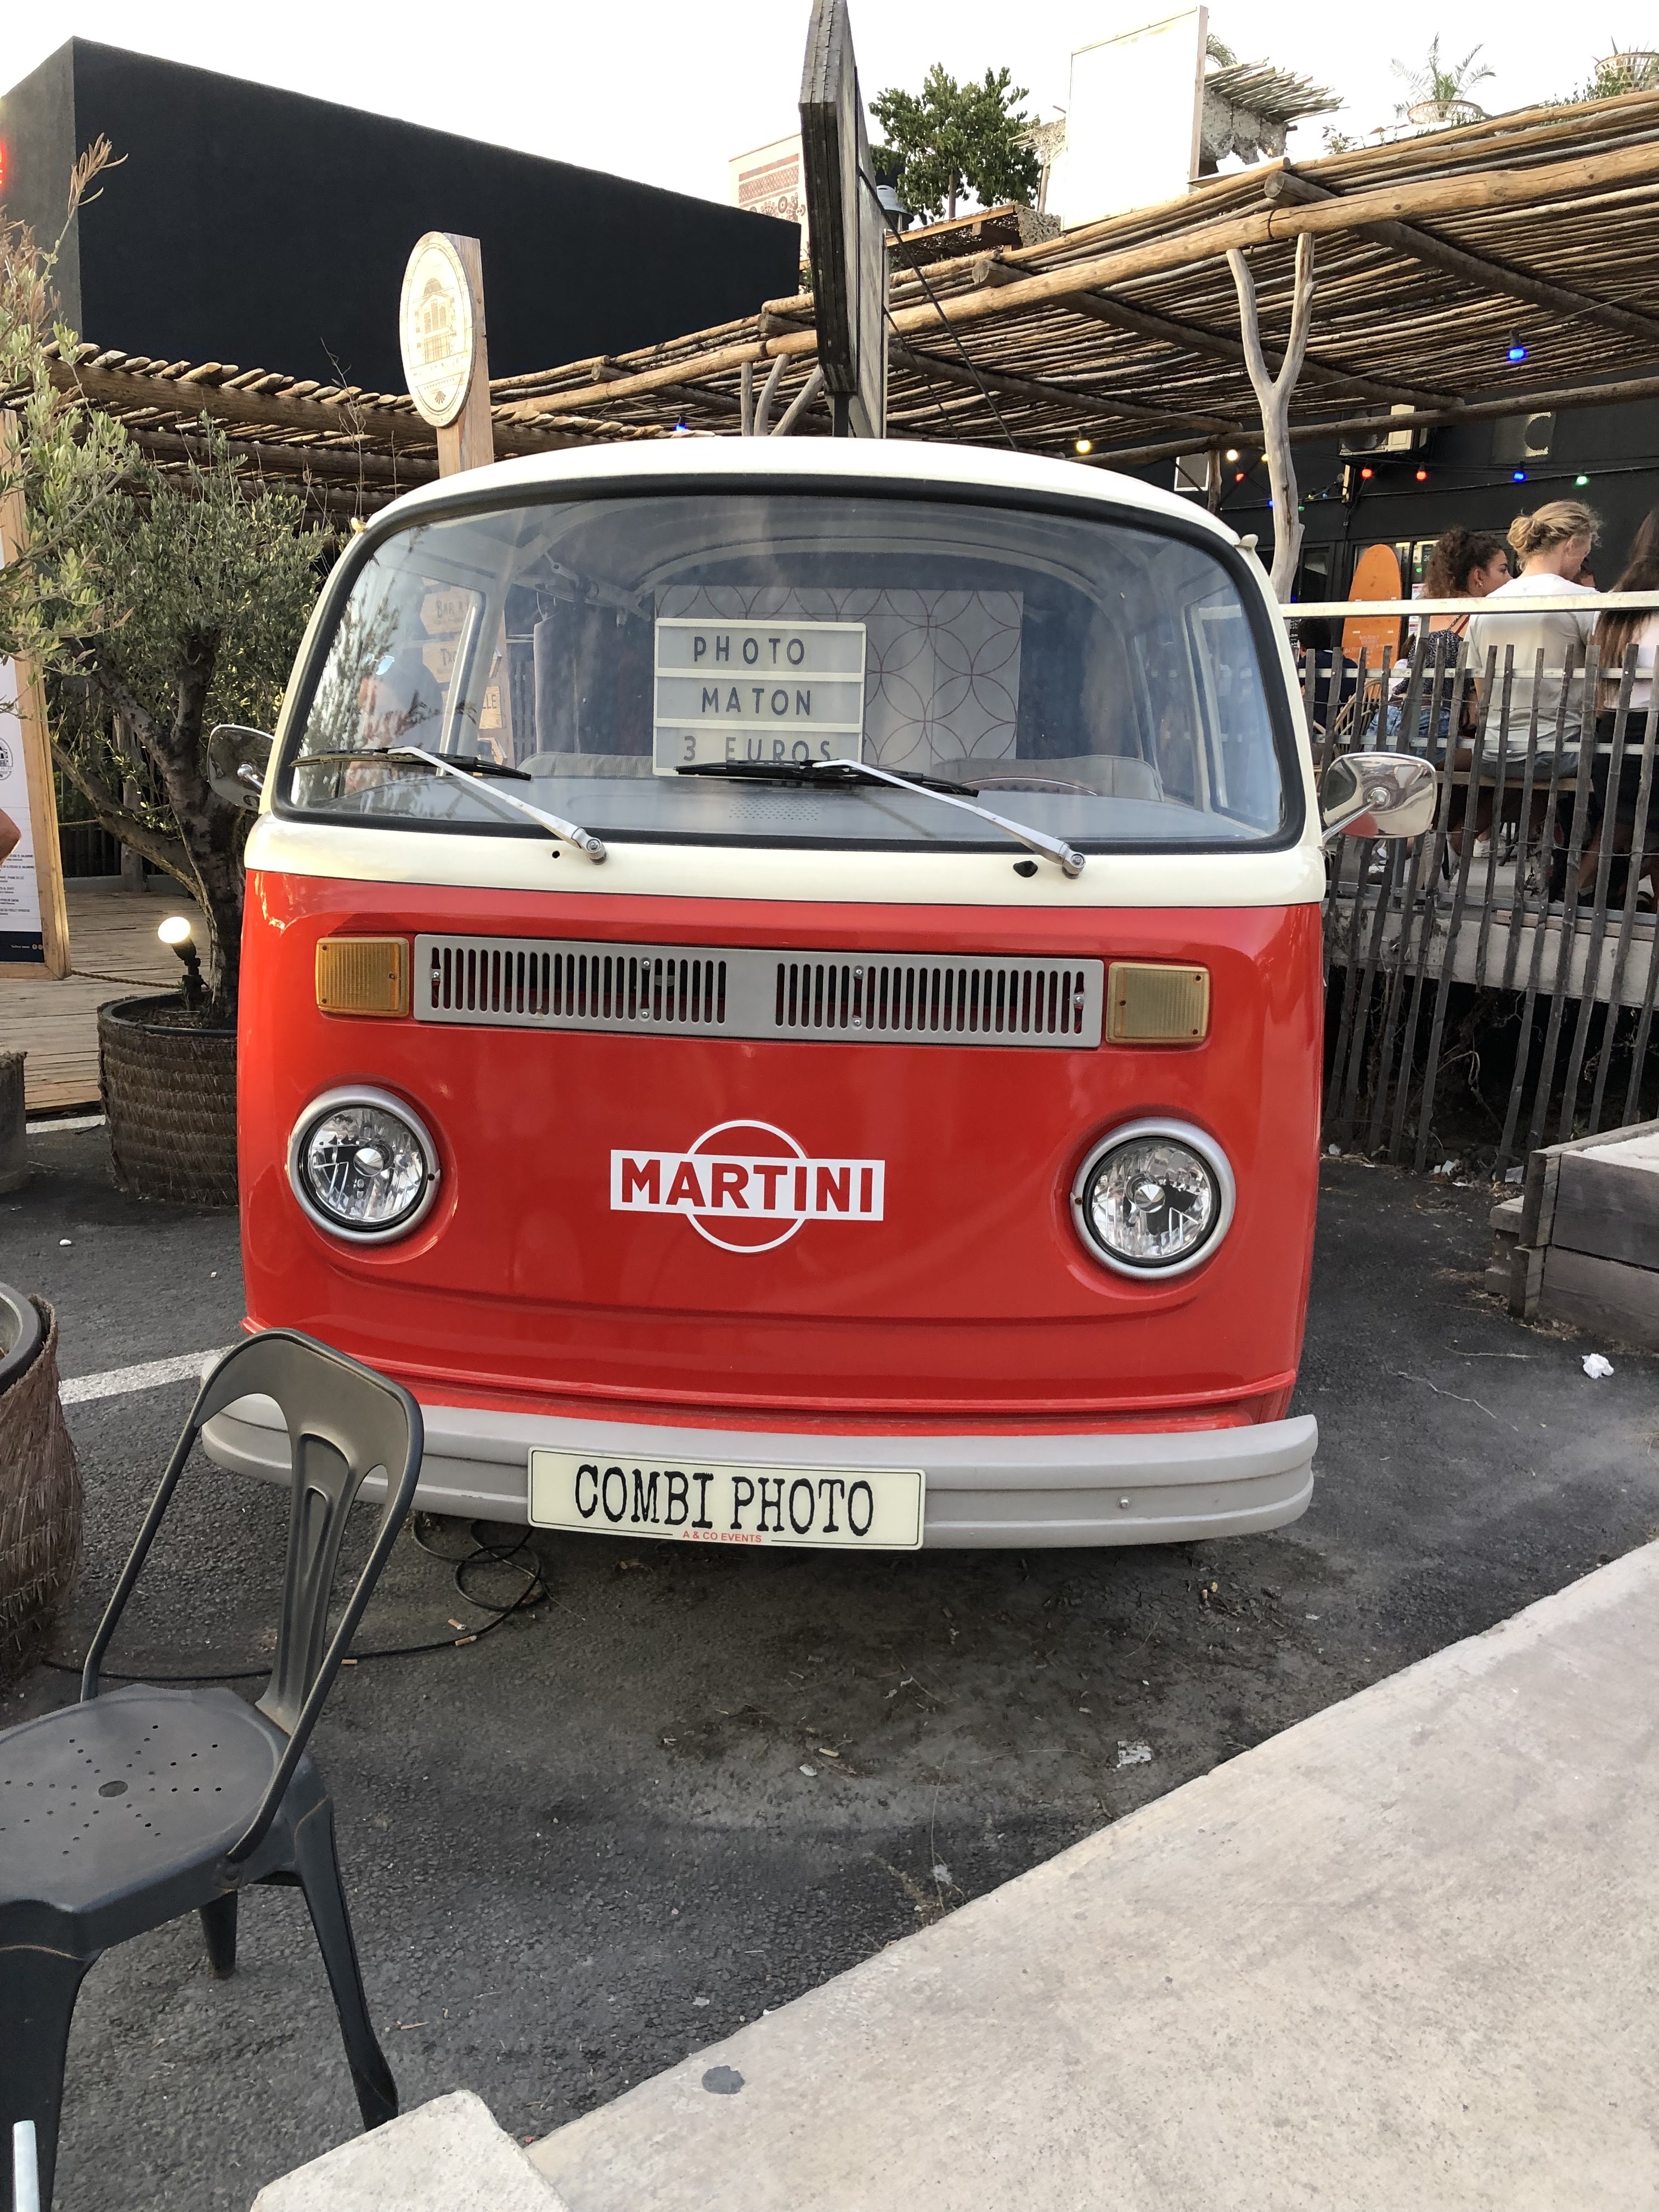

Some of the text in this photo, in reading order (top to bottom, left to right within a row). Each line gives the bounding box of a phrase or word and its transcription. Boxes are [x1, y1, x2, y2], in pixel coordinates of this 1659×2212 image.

[693, 635, 805, 665] PHOTO
[702, 686, 811, 716] MATON
[683, 735, 831, 761] 3 EUROS
[621, 1158, 873, 1213] MARTINI
[575, 1464, 874, 1537] COMBI PHOTO
[703, 1532, 718, 1540] CO
[721, 1533, 762, 1543] EVENTS
